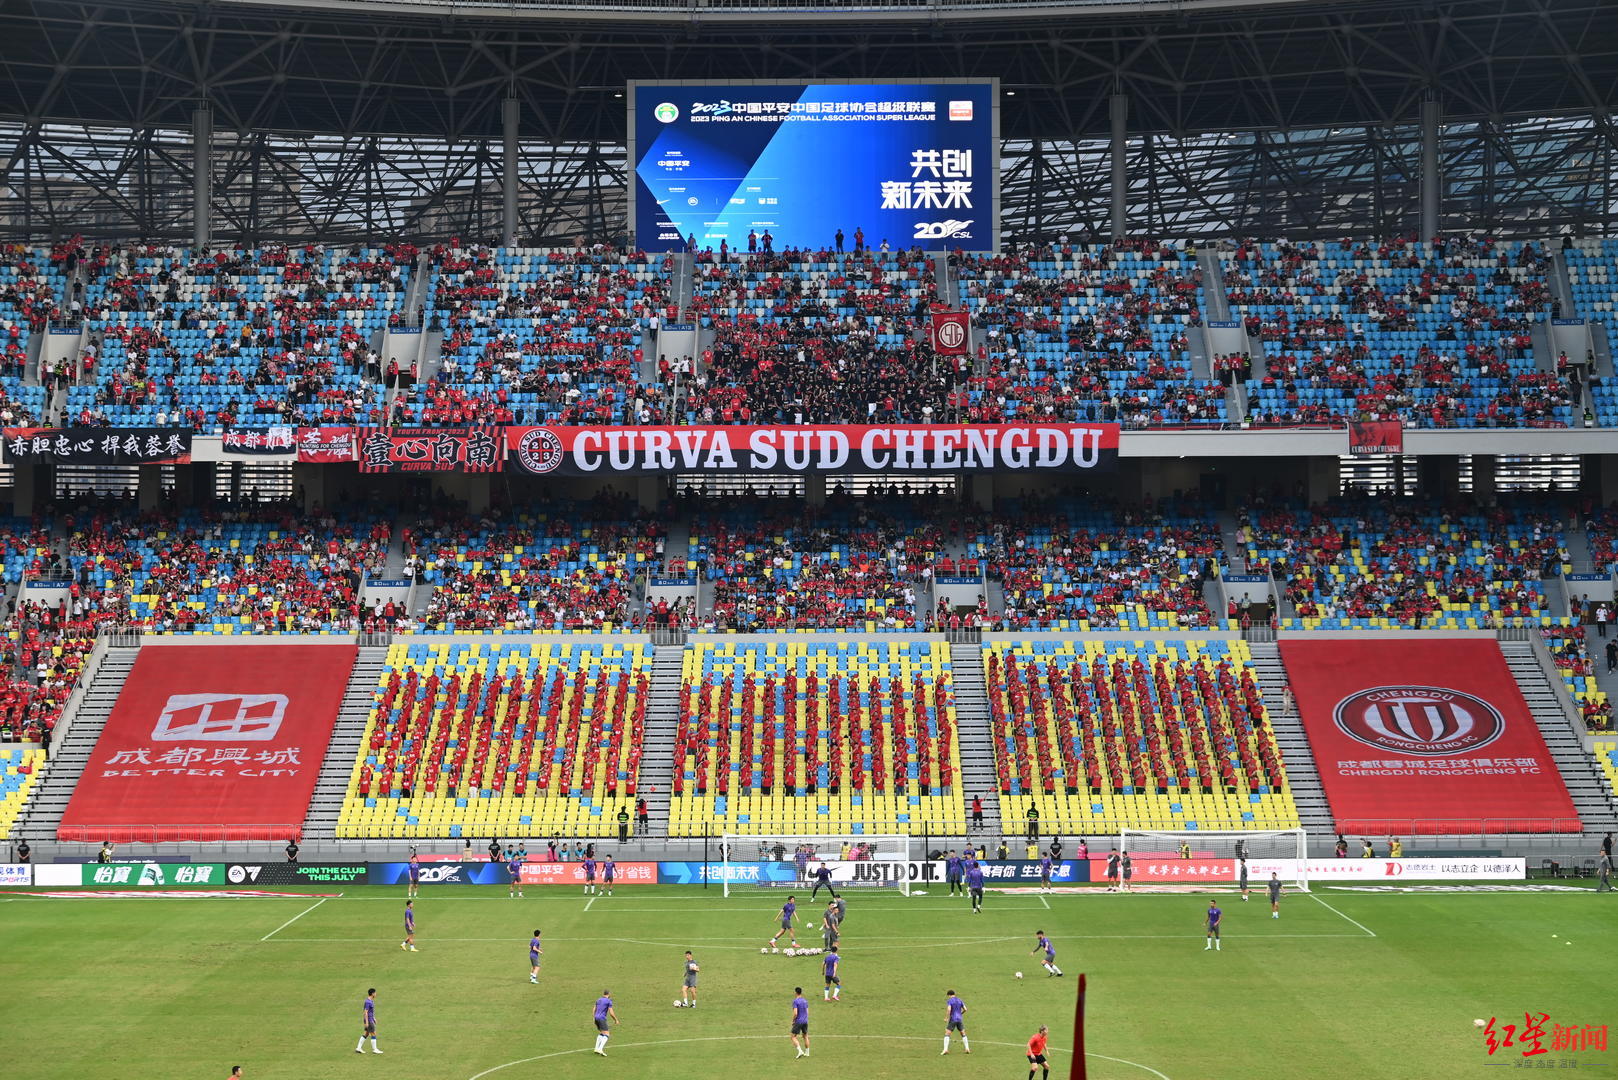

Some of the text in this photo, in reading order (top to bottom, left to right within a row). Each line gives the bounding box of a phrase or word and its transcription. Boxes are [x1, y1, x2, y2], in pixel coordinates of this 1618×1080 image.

[910, 149, 972, 178] 共创
[880, 180, 973, 209] 新未来
[913, 222, 948, 239] 20
[952, 231, 973, 239] CSL
[525, 431, 541, 443] SUD
[8, 433, 186, 457] 赤胆忠心 捍我蓉誉
[573, 428, 1104, 472] CURVA SUD CHENGDU
[401, 461, 455, 471] CURVA SUD
[1366, 690, 1455, 702] CHENGDU
[1376, 735, 1478, 750] RONGCHENG FC
[100, 768, 301, 778] BETTER CITY
[1339, 767, 1541, 776] CHENGDU RONGCHENG FC
[852, 863, 890, 881] JUST
[893, 863, 919, 881] DO
